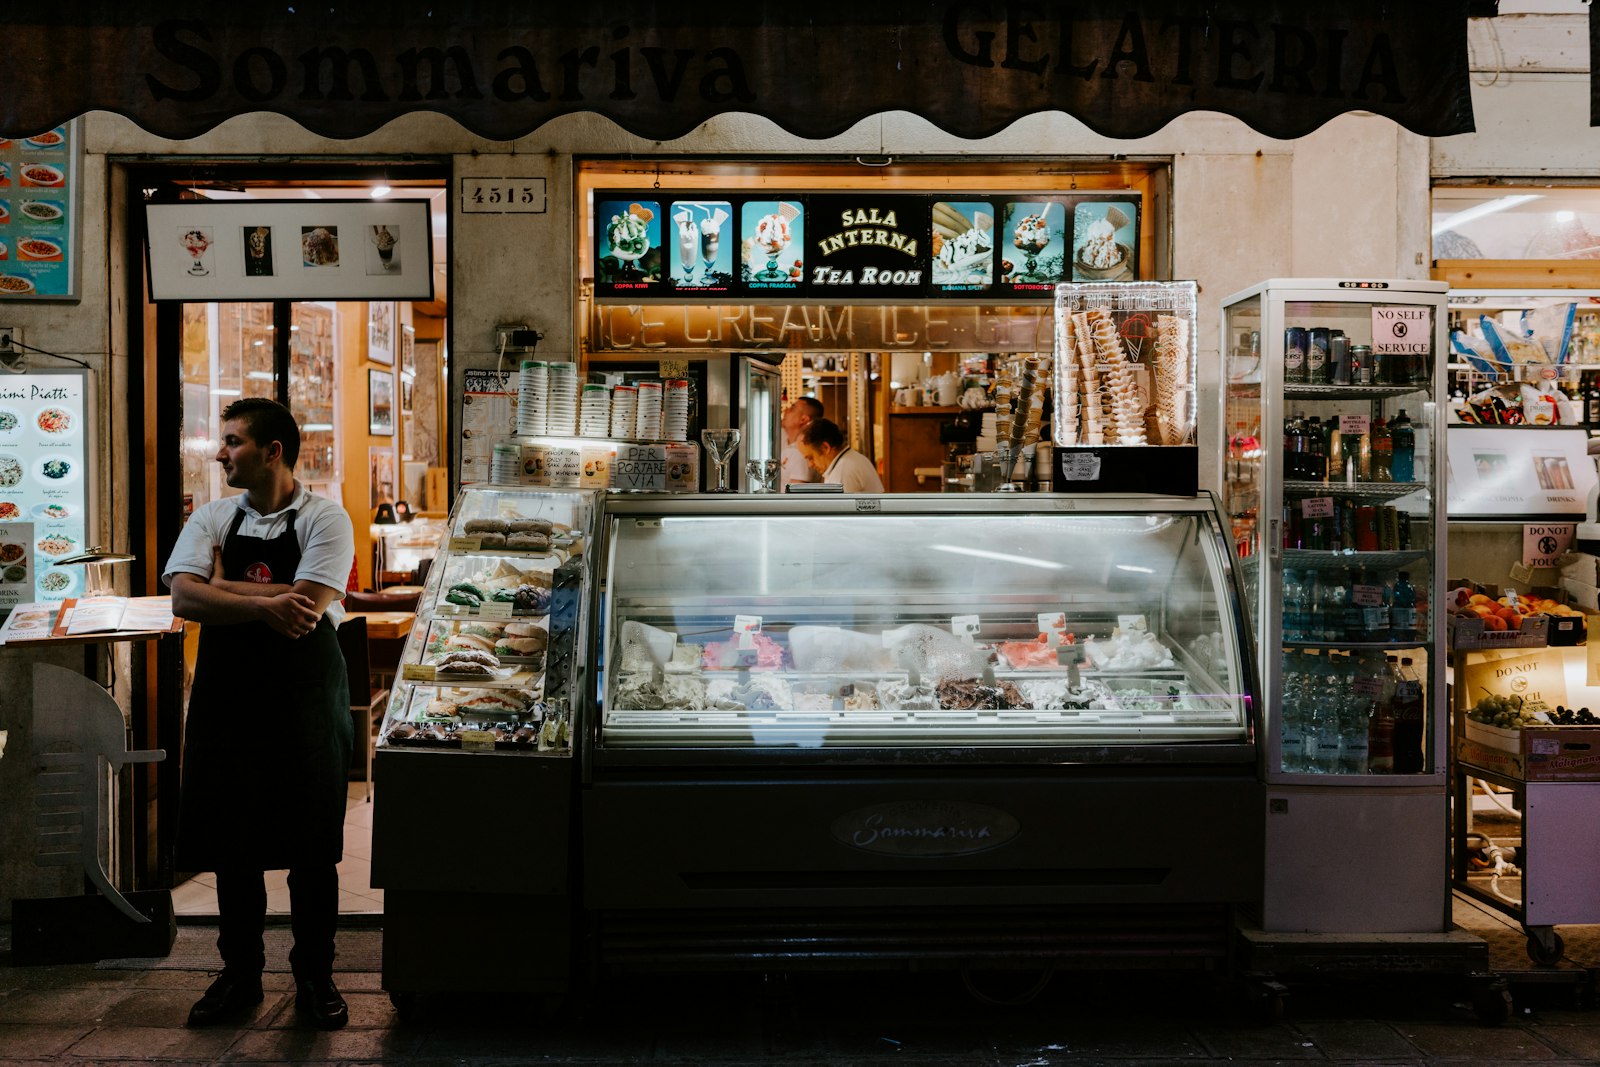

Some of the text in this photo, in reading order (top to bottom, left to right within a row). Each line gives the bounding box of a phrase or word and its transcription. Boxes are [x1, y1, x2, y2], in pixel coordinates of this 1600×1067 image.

[144, 18, 757, 103] Sommariva
[942, 1, 1407, 104] GELATERIA
[472, 187, 534, 204] 4515
[842, 208, 898, 227] SALA
[818, 229, 918, 257] INTERNA
[1060, 292, 1081, 310] EIS
[1086, 292, 1112, 310] ZUM
[686, 305, 853, 342] CREAM
[1377, 311, 1426, 320] NO SELF
[1378, 343, 1428, 352] SERVICE
[31, 384, 68, 400] Piatti
[628, 448, 659, 460] PER
[617, 462, 666, 474] PORTARE
[1529, 527, 1569, 535] DO NOT
[1531, 558, 1559, 567] TOUC
[1477, 633, 1488, 641] LA
[1495, 662, 1540, 678] DO NOT
[852, 814, 992, 846] Sommariva
